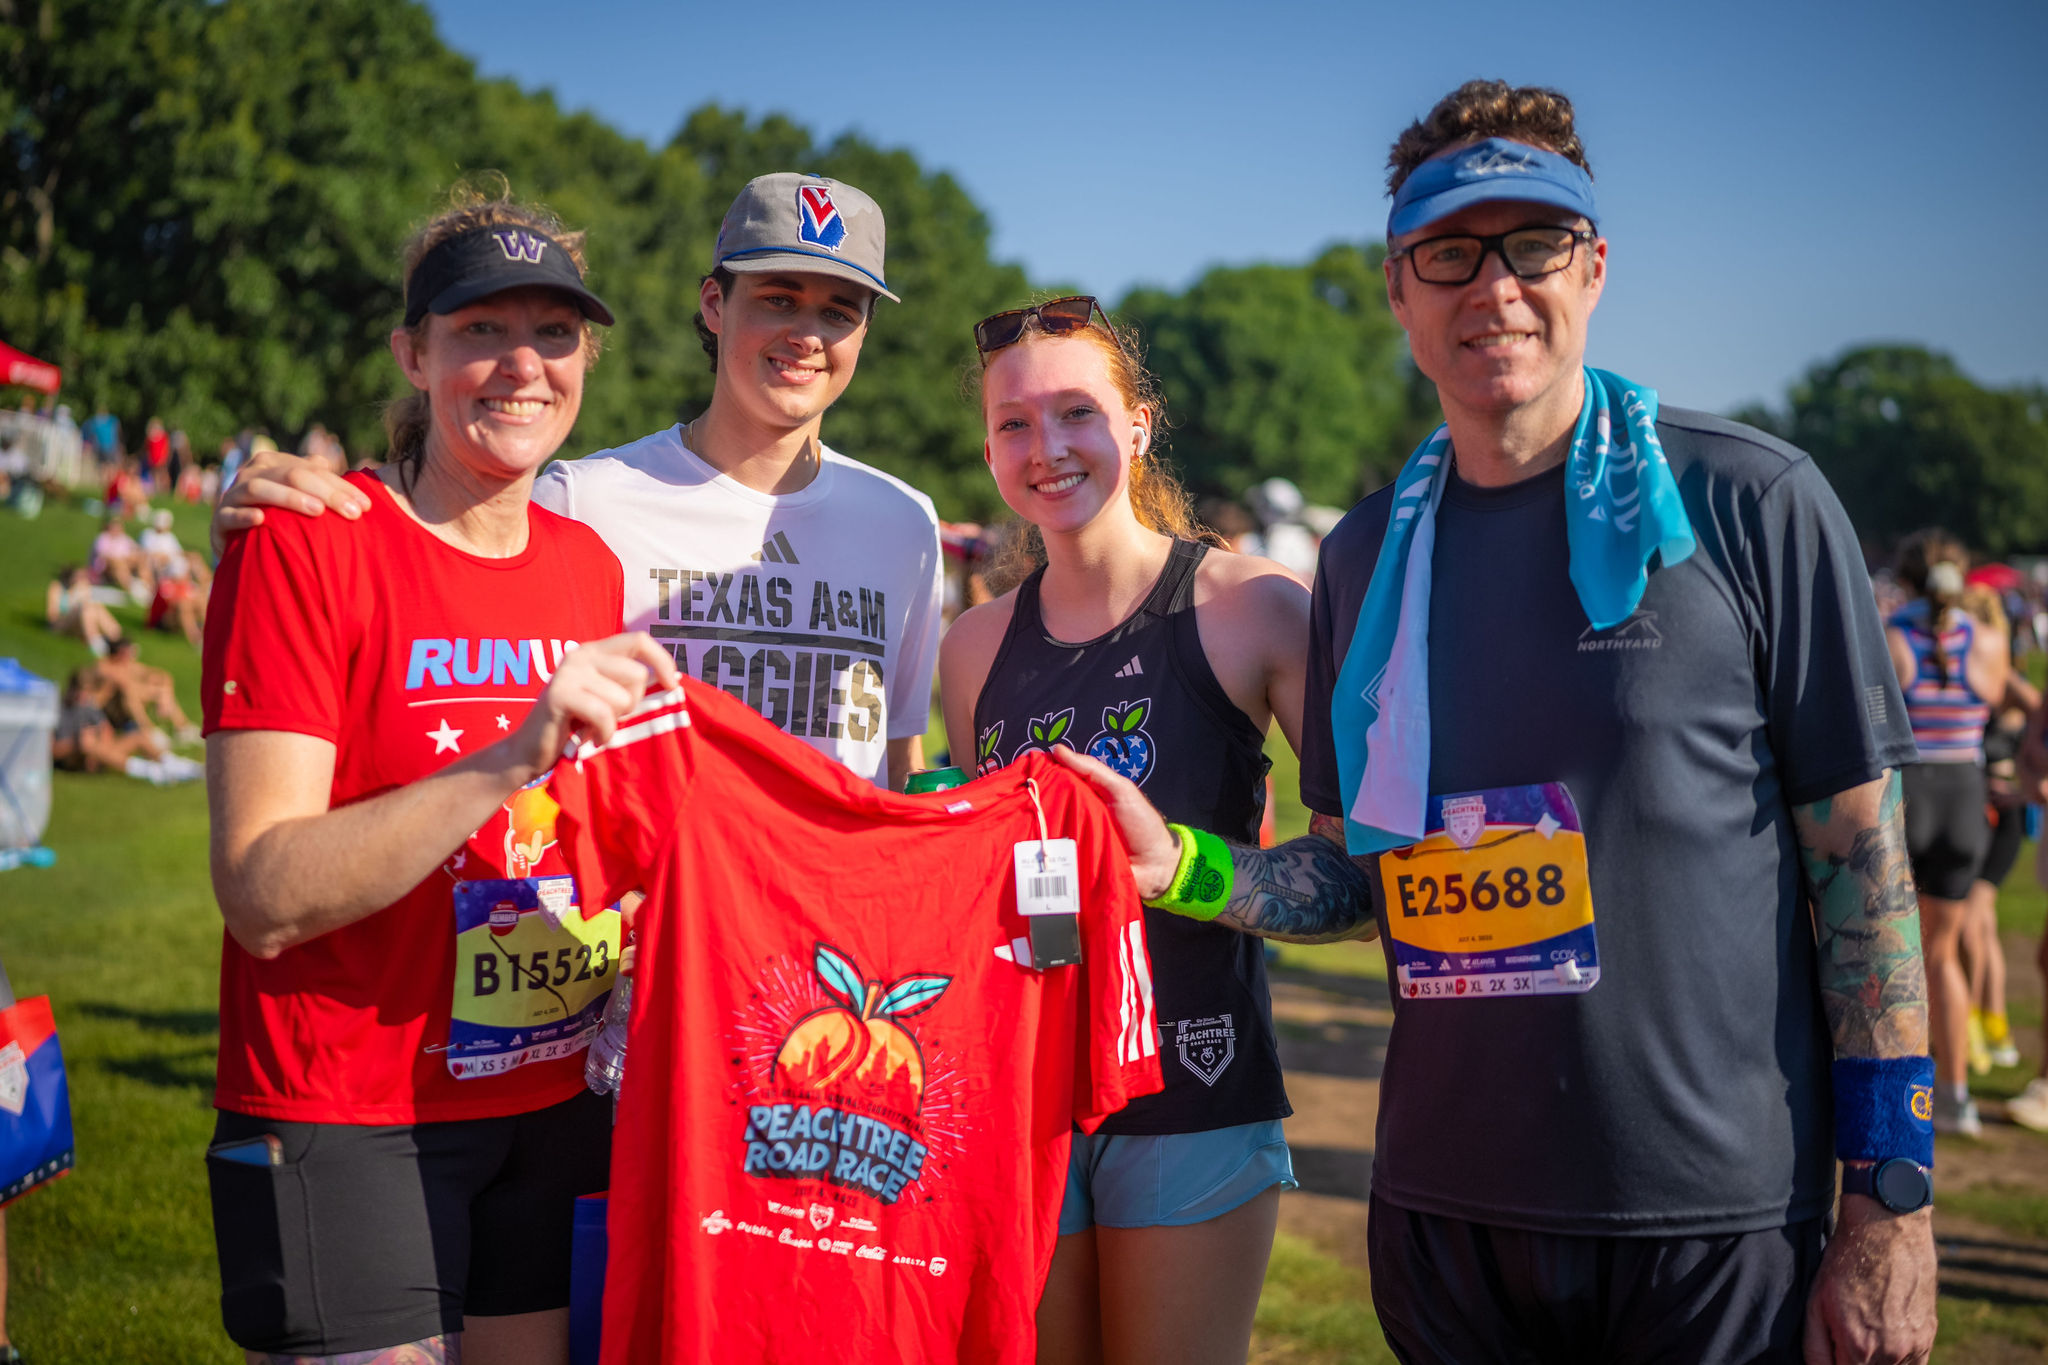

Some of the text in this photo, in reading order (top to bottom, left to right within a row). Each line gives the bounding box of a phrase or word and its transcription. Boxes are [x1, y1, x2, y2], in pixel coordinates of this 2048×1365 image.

[493, 230, 547, 263] W
[650, 568, 886, 641] TEXAS A&M
[1577, 639, 1663, 652] NORTHYARD
[1397, 864, 1565, 918] E25688
[474, 940, 609, 997] B15523
[1550, 949, 1579, 962] COX
[1420, 983, 1431, 995] XS
[1435, 983, 1441, 995] S
[1445, 982, 1454, 993] M
[1470, 981, 1483, 992] XL
[1490, 978, 1506, 991] 2X
[1513, 977, 1530, 990] 3X
[1175, 1028, 1236, 1044] PEACHTREE
[480, 1060, 495, 1072] XS
[546, 1047, 558, 1057] 2X
[744, 1104, 929, 1182] PEACHTREE
[744, 1141, 831, 1173] ROAD
[833, 1149, 909, 1203] RACE
